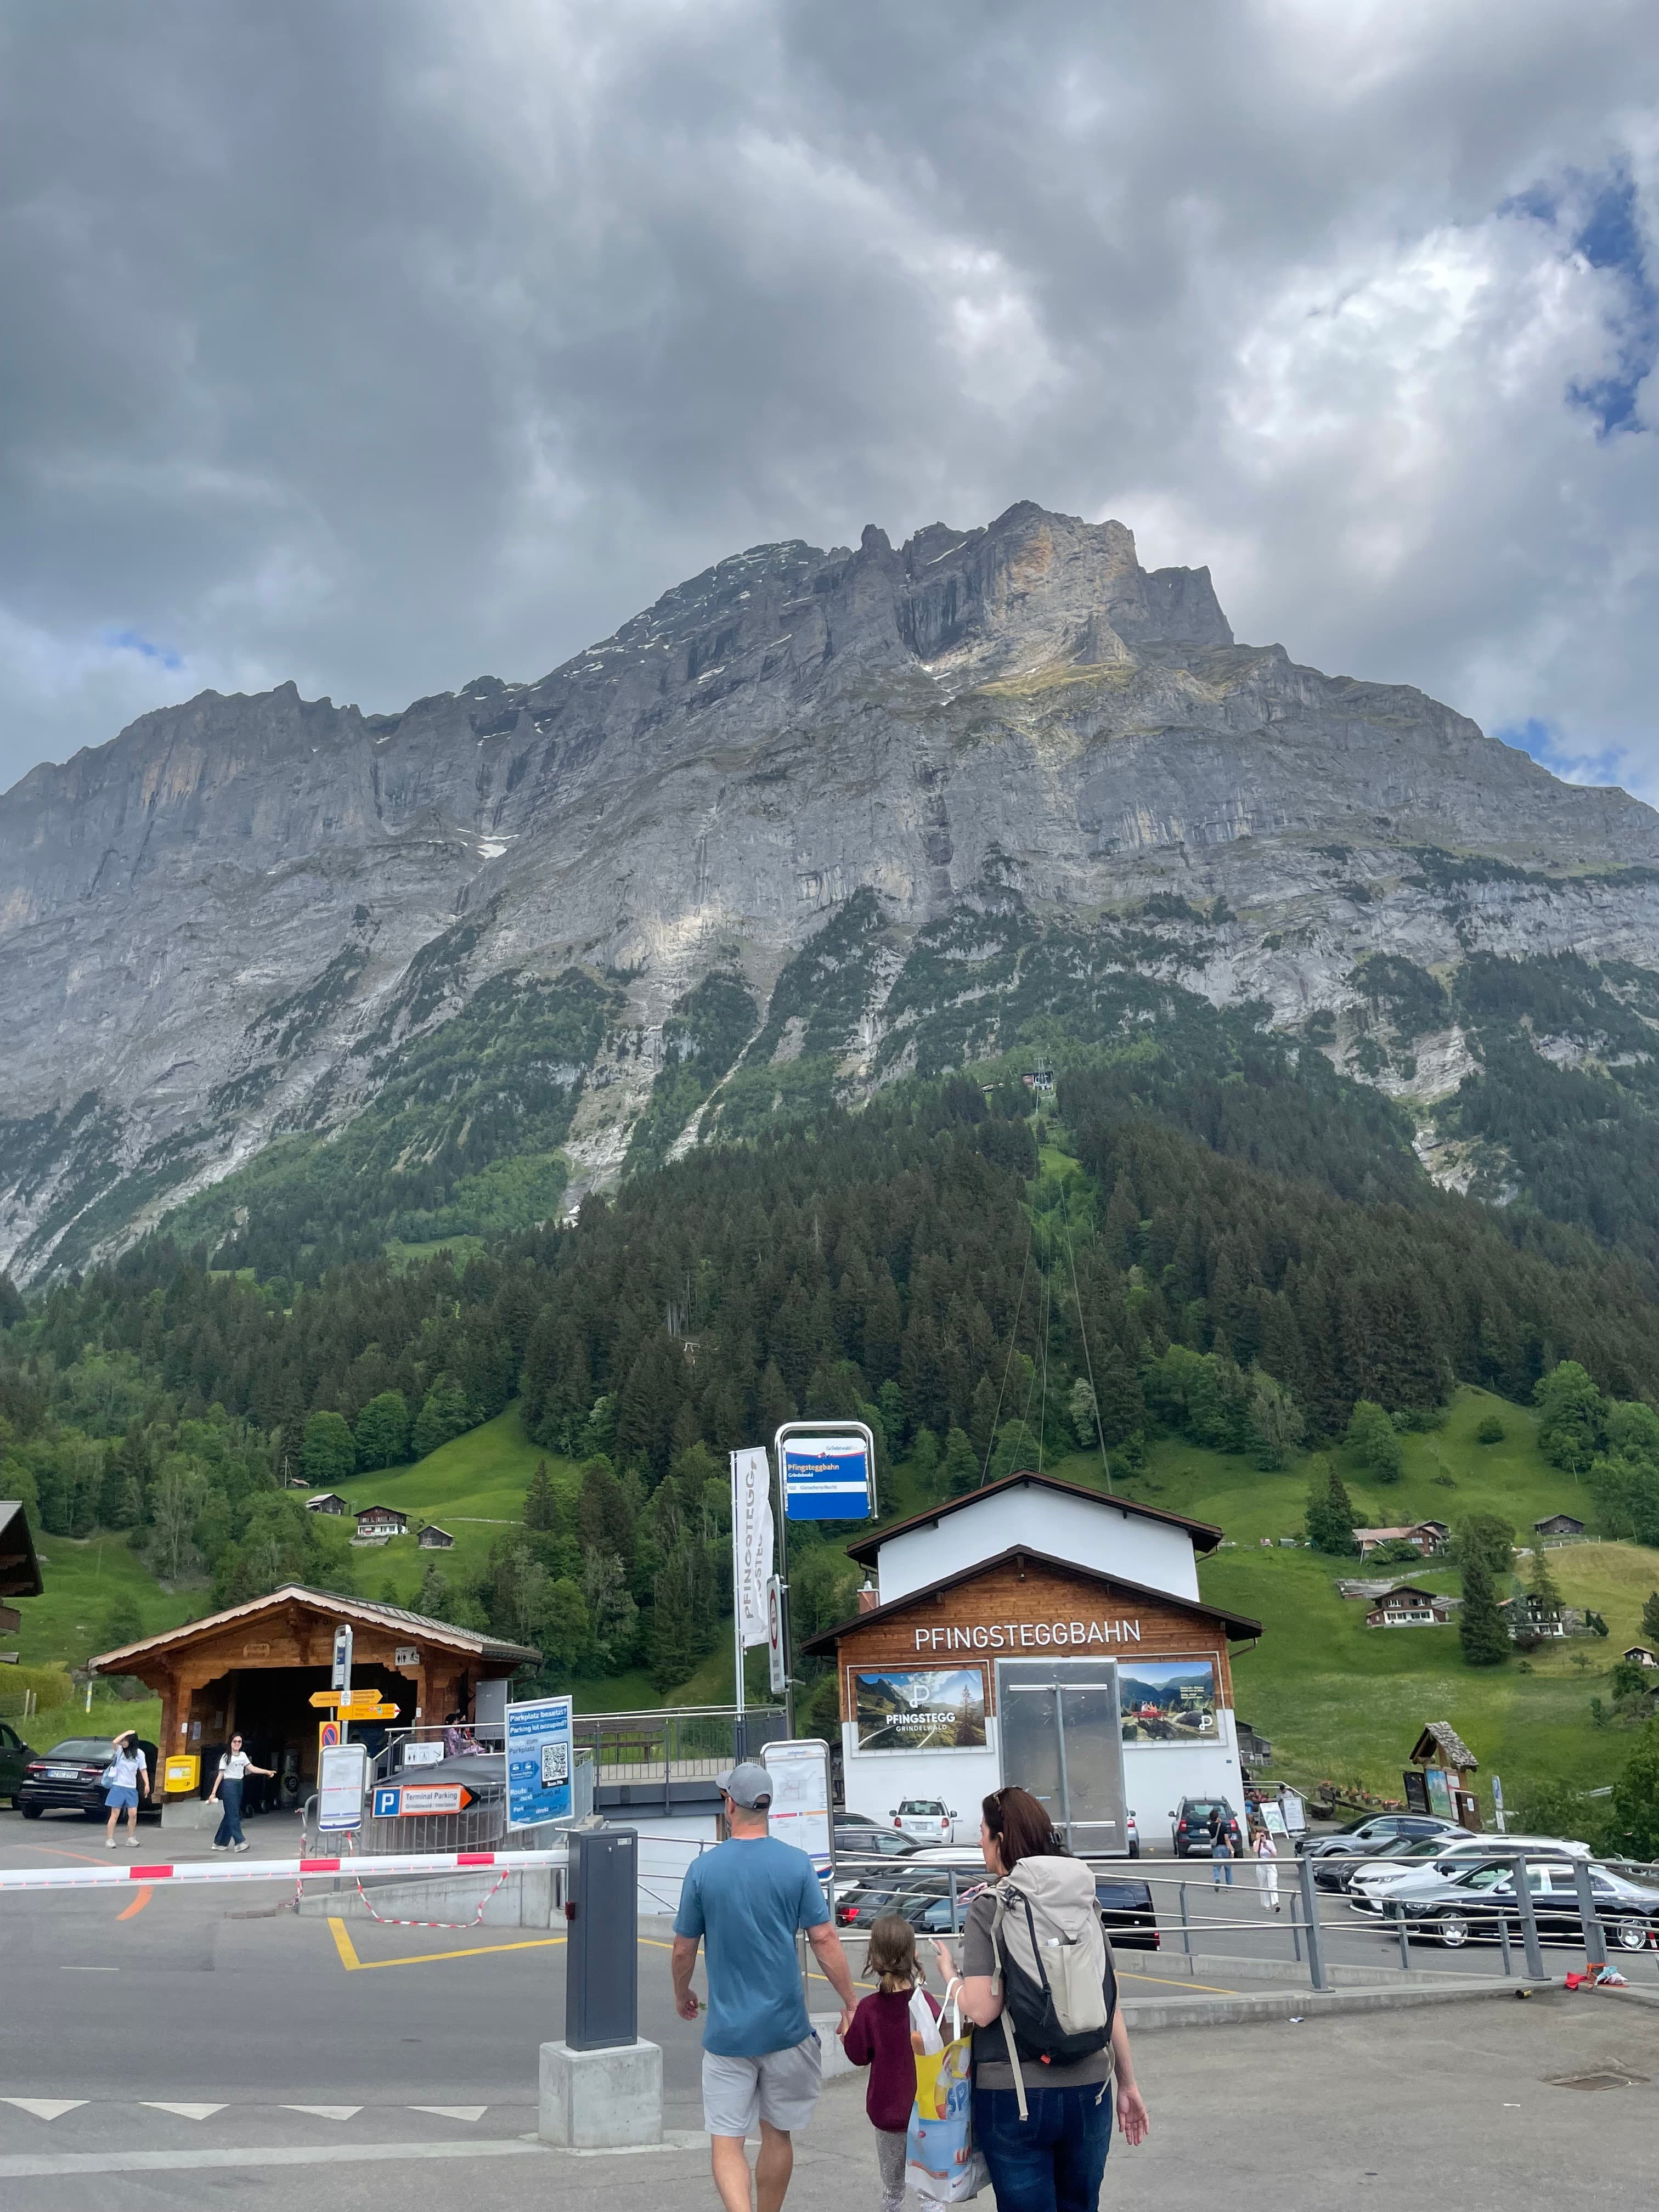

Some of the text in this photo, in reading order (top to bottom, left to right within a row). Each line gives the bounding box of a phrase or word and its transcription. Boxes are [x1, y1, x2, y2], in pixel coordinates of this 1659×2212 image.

[787, 1463, 839, 1472] Pfingsteggbahn
[915, 1620, 1141, 1650] PFINGSTEGGBAHN
[510, 1708, 567, 1722] Parkplatz besetzt?
[886, 1712, 956, 1724] PFINGSTEGG
[540, 1720, 567, 1729] occupied?
[509, 1746, 535, 1754] Parkplatz
[381, 1793, 394, 1813] P
